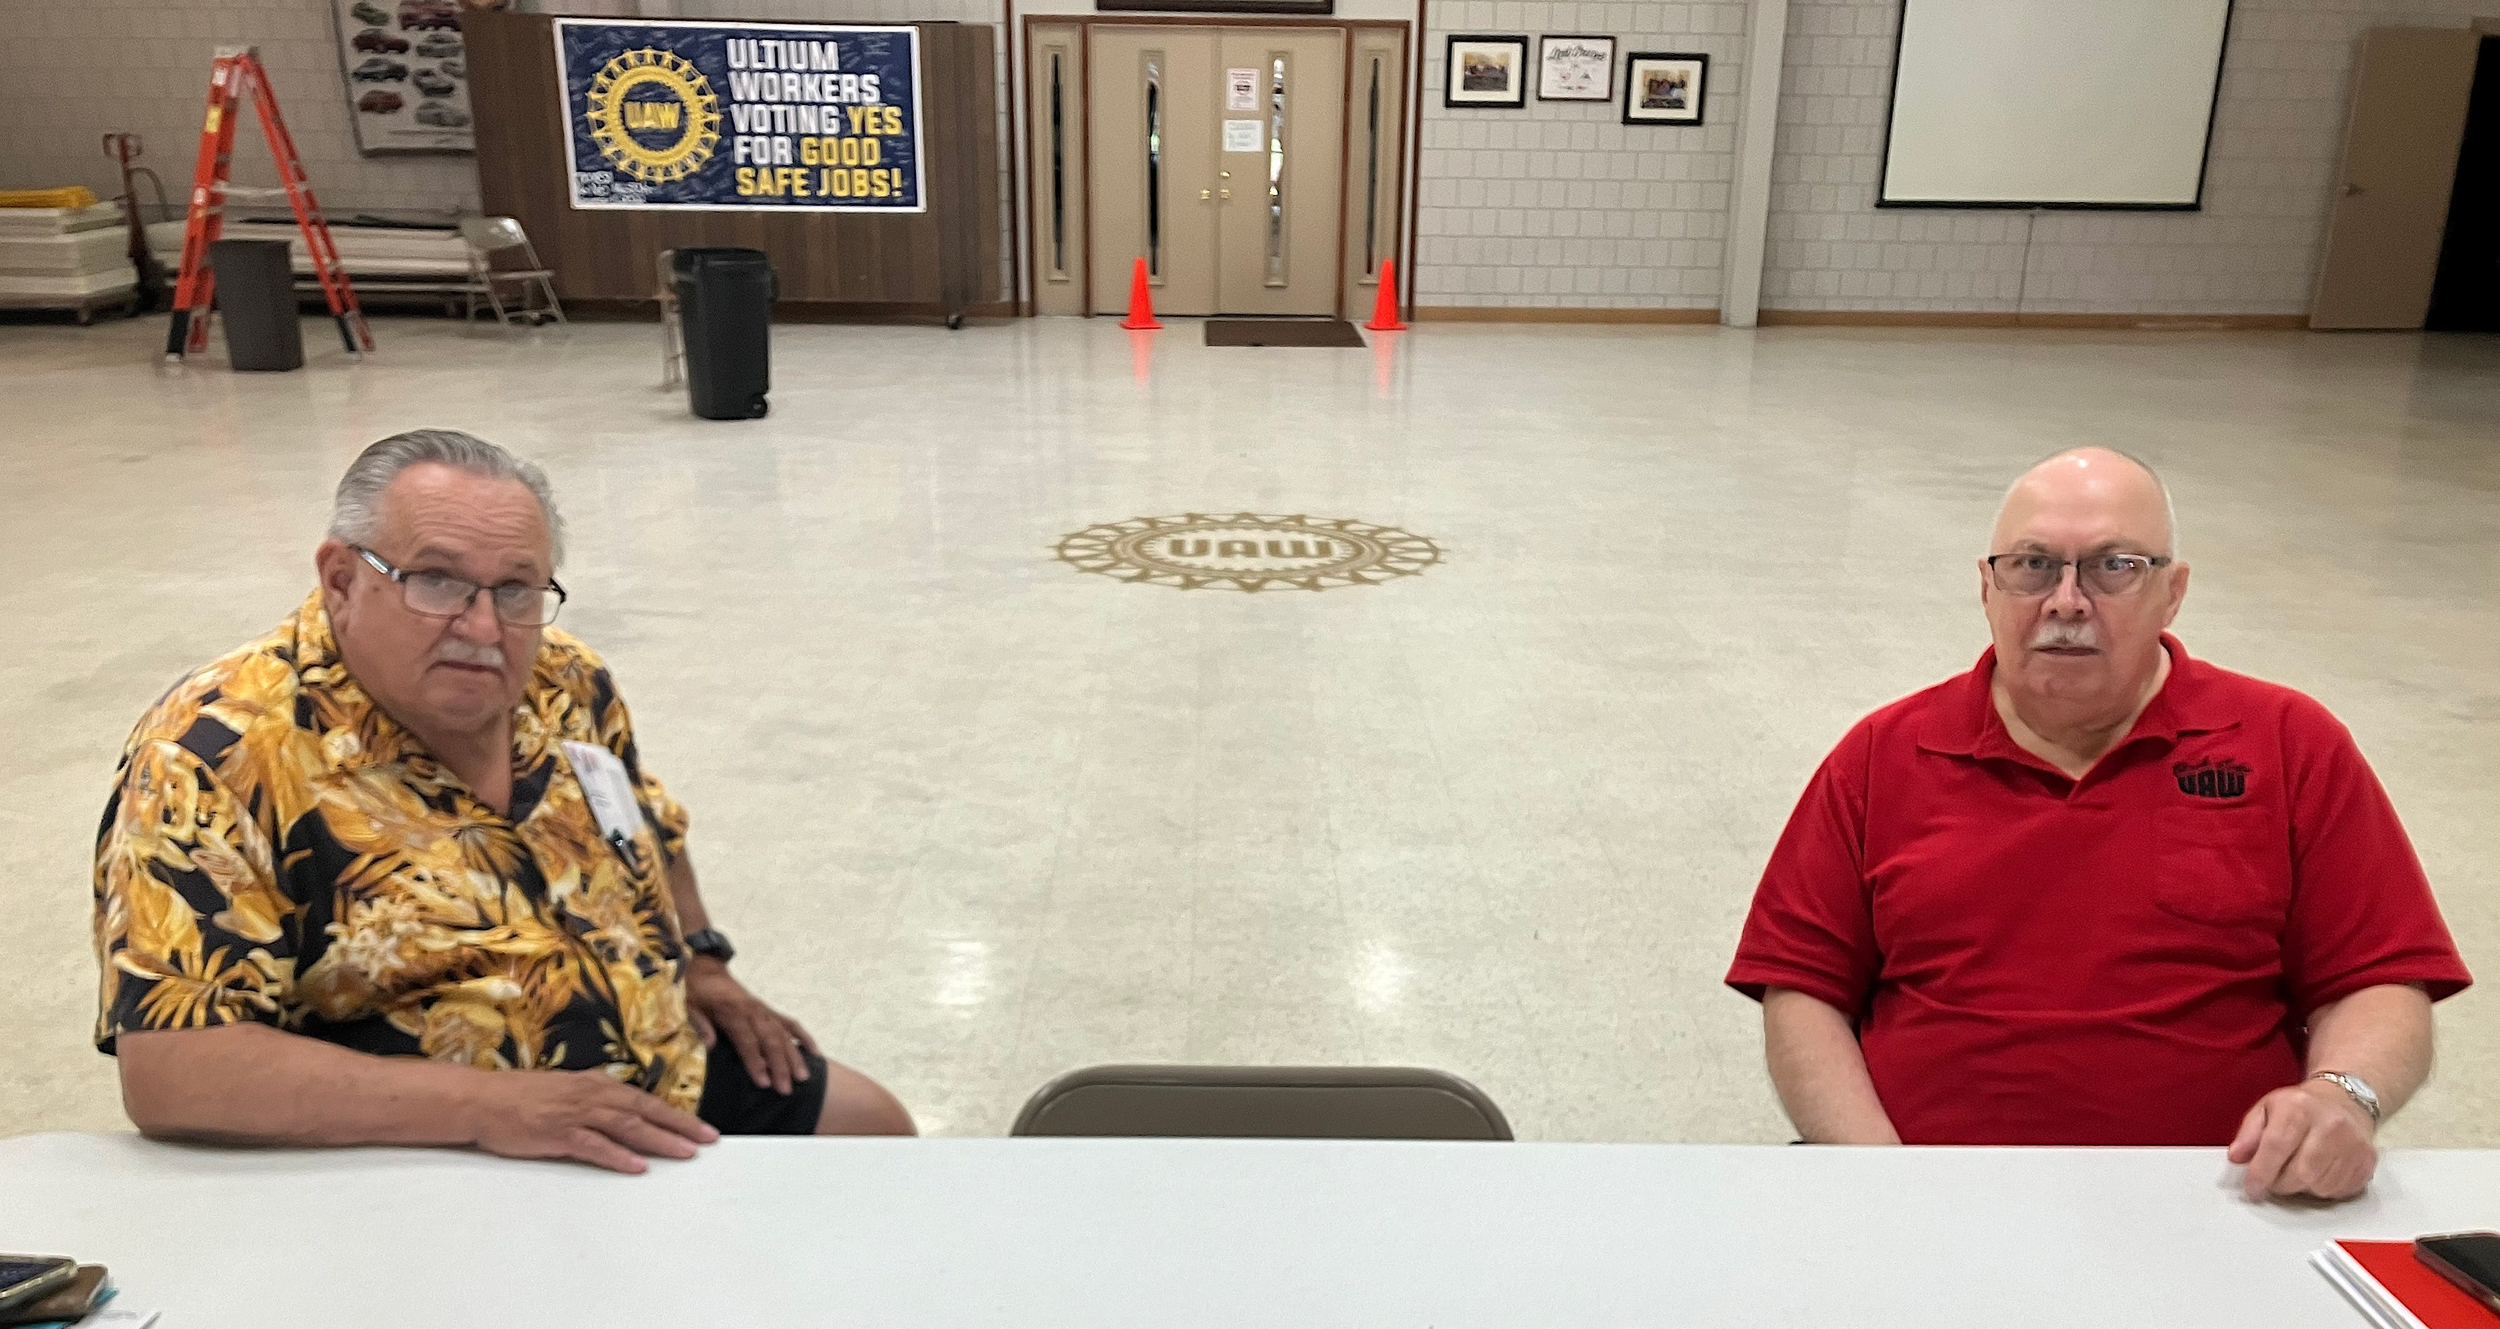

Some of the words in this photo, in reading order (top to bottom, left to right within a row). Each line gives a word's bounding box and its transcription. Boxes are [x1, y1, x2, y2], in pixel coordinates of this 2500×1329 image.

[726, 38, 840, 71] ULTIUM
[727, 71, 881, 103] WORKERS
[623, 101, 681, 130] UAW
[730, 104, 841, 134] VOTING
[845, 106, 904, 135] YES
[733, 135, 794, 165] FOR
[799, 136, 882, 166] GOOD
[734, 166, 812, 196] SAFE
[815, 168, 904, 197] JOBS!
[1170, 540, 1333, 558] UAW
[2178, 769, 2246, 797] UAW
